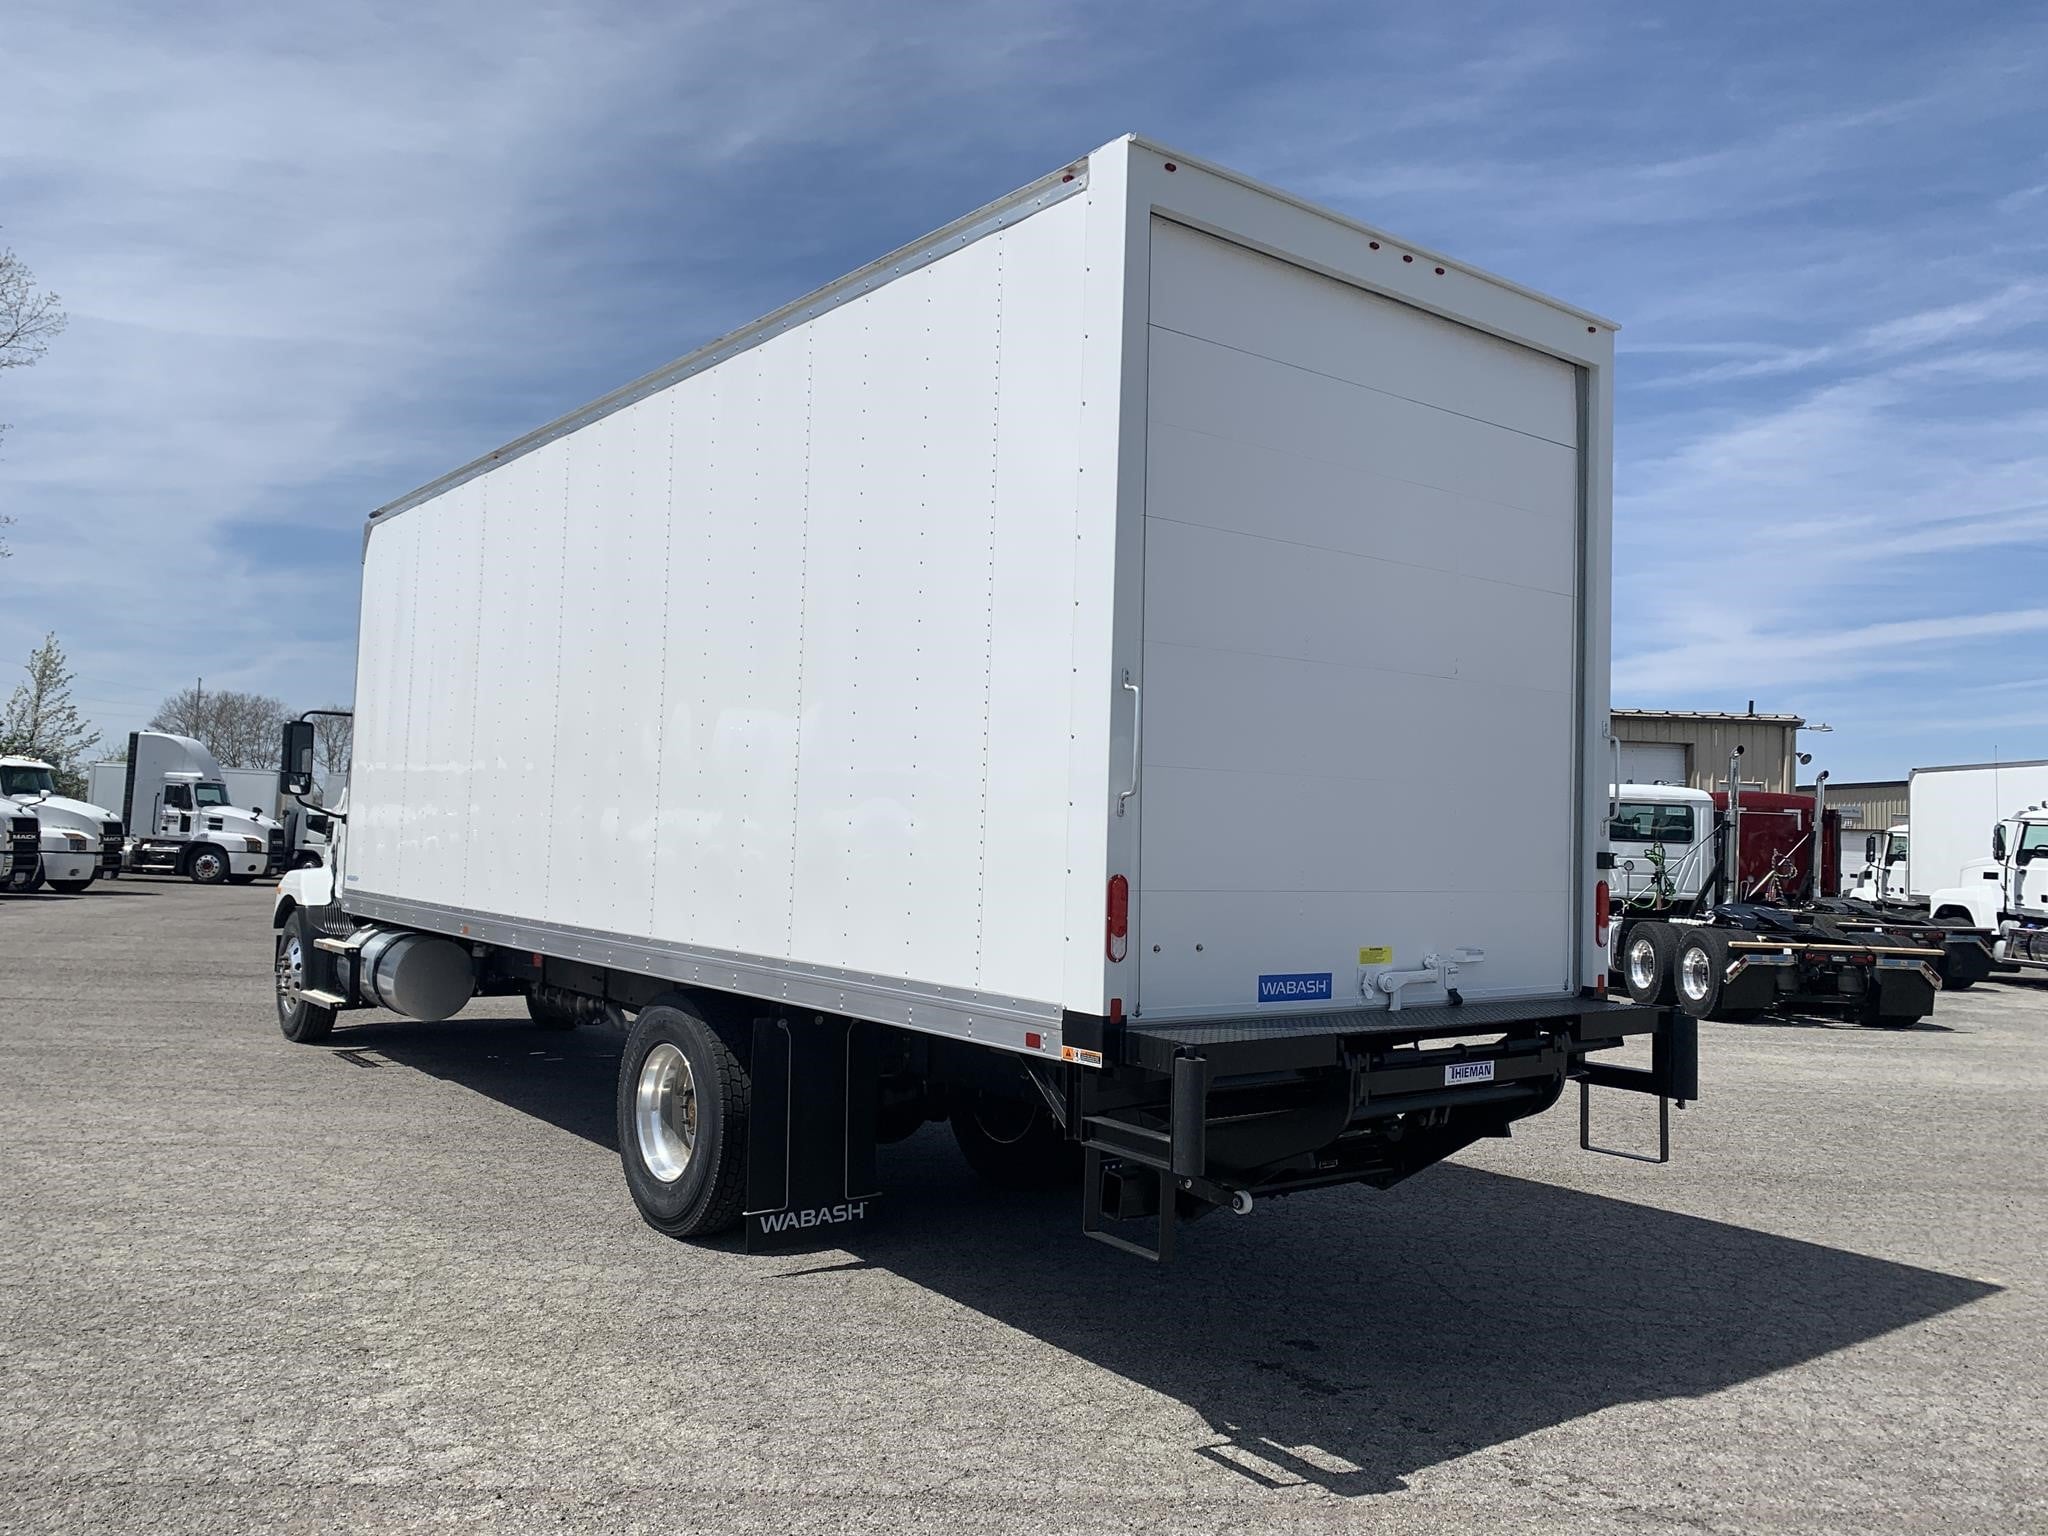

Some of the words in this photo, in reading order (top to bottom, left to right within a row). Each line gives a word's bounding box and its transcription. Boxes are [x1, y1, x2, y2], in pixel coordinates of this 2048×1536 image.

[1261, 979, 1327, 995] WABASH
[1449, 1062, 1491, 1079] THIEMAN
[760, 1202, 864, 1234] WABASH
